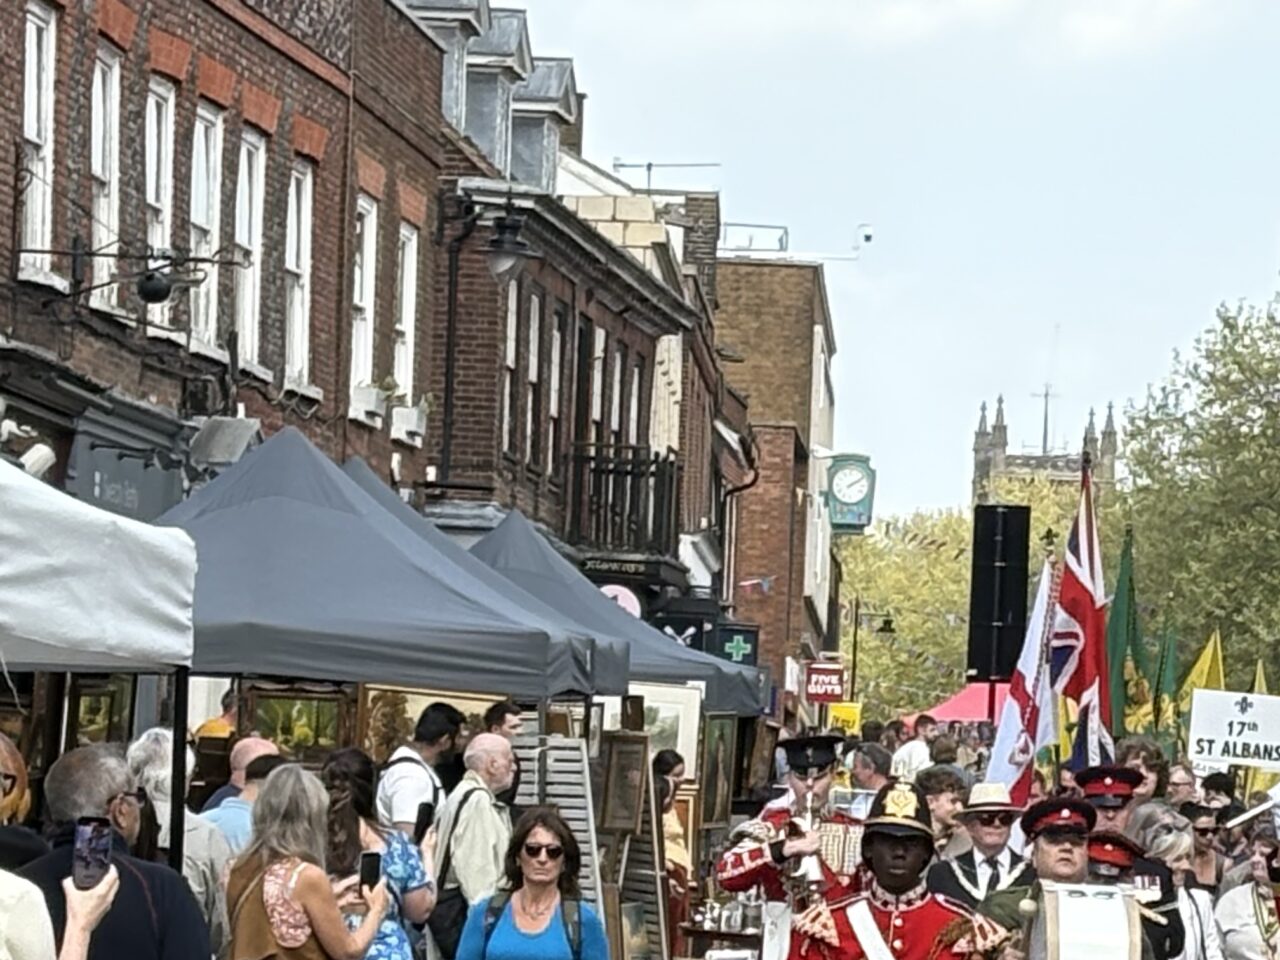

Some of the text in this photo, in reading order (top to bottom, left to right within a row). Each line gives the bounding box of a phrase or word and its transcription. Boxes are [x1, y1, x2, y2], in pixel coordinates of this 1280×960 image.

[811, 674, 839, 684] FIVE
[807, 684, 842, 695] GUYS
[1226, 720, 1259, 737] 17th
[1195, 738, 1215, 754] ST
